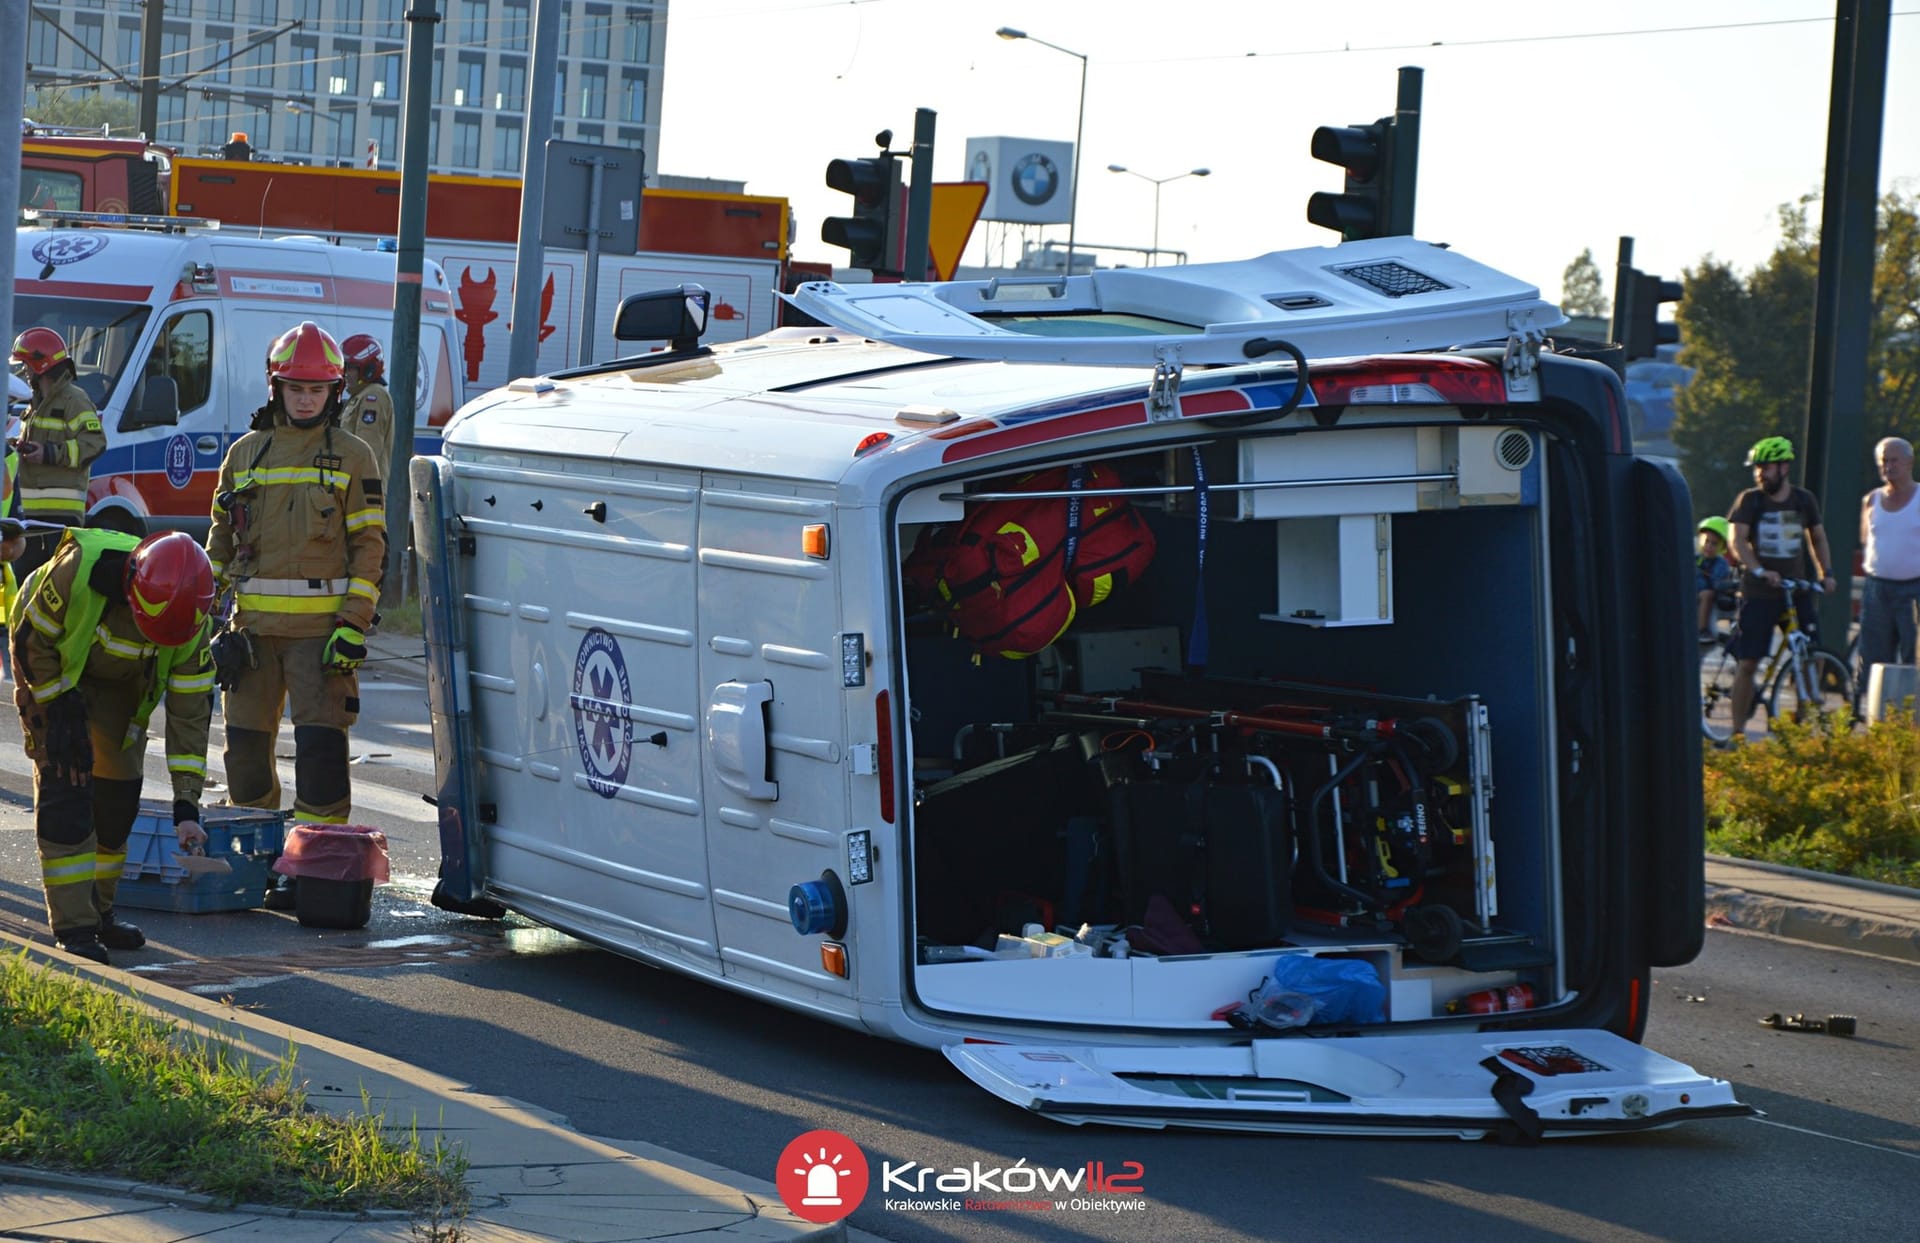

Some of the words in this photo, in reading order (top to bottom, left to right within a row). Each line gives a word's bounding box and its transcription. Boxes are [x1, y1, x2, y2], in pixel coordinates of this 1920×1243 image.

[43, 583, 59, 605] PSP
[575, 632, 614, 693] RATOWNICTWO
[618, 664, 631, 771] MEDYCZNE
[1416, 803, 1427, 836] FERNO
